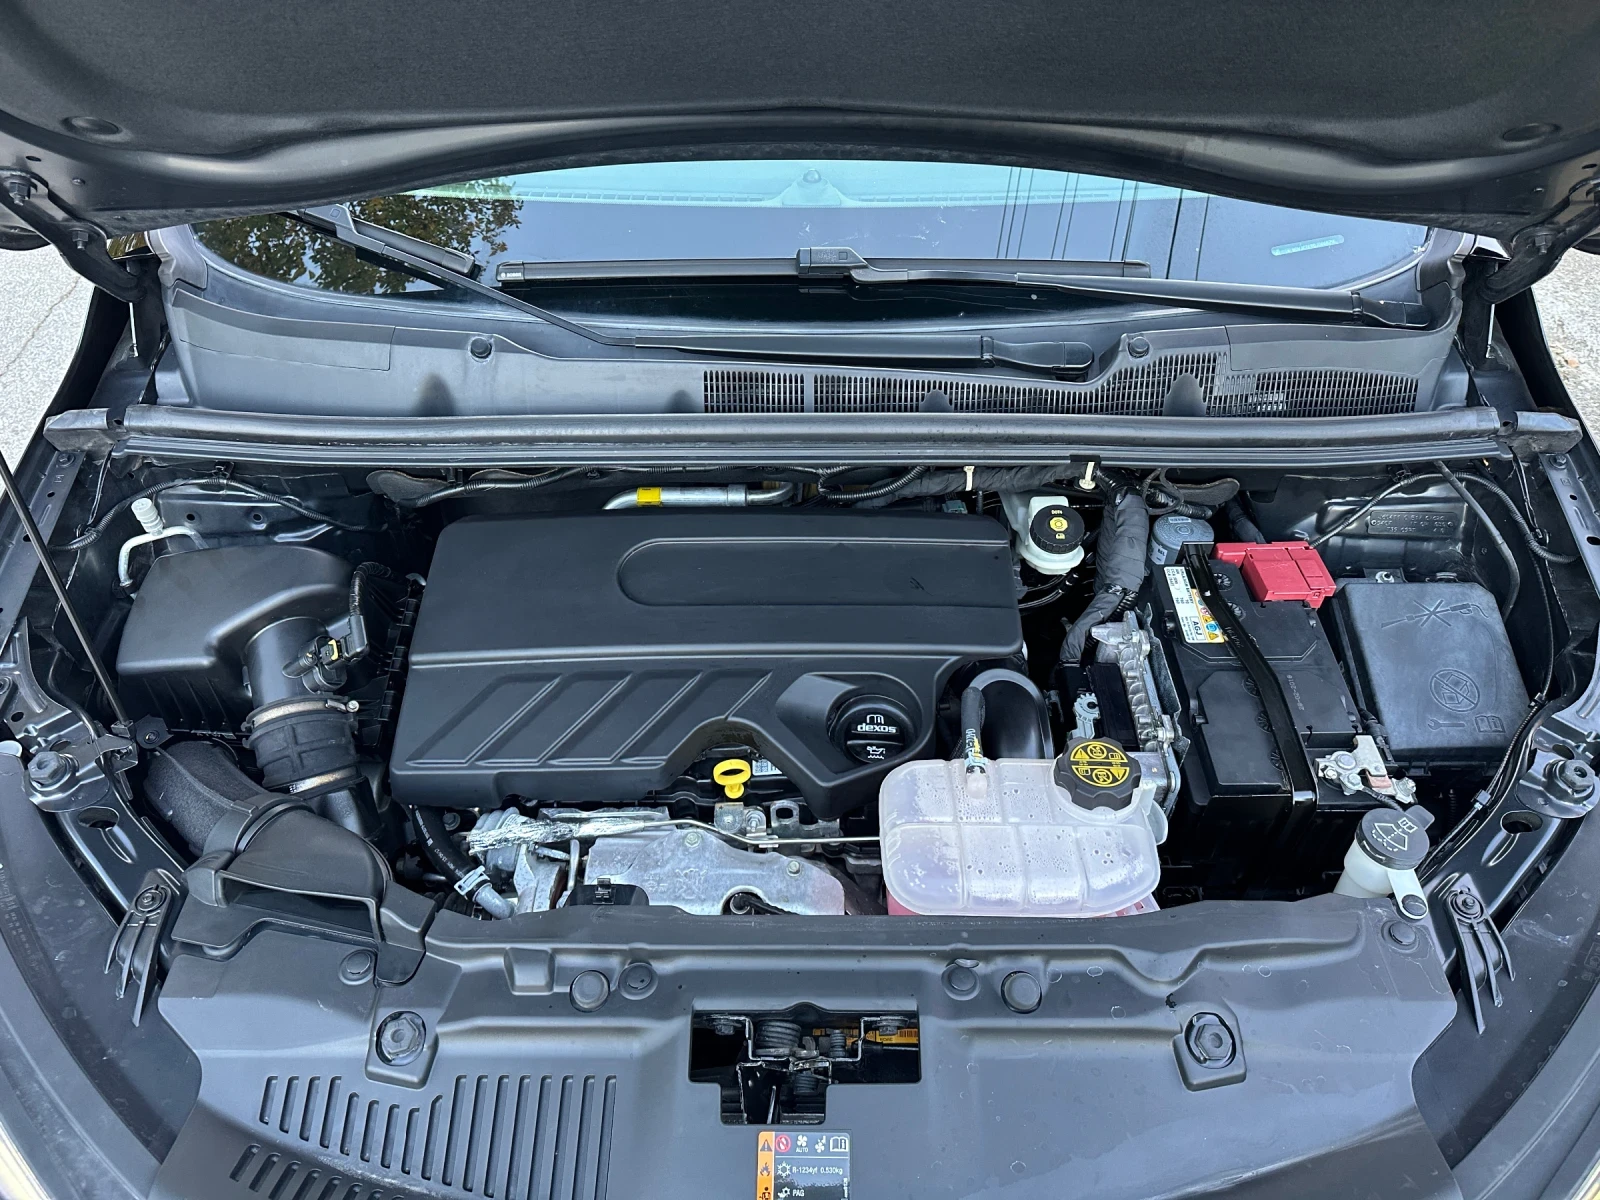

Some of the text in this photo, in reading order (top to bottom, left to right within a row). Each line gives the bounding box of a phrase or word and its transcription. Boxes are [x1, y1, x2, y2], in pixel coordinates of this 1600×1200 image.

[857, 723, 897, 733] dexos
[792, 1166, 818, 1174] R-1234yf
[792, 1189, 805, 1197] PAG
